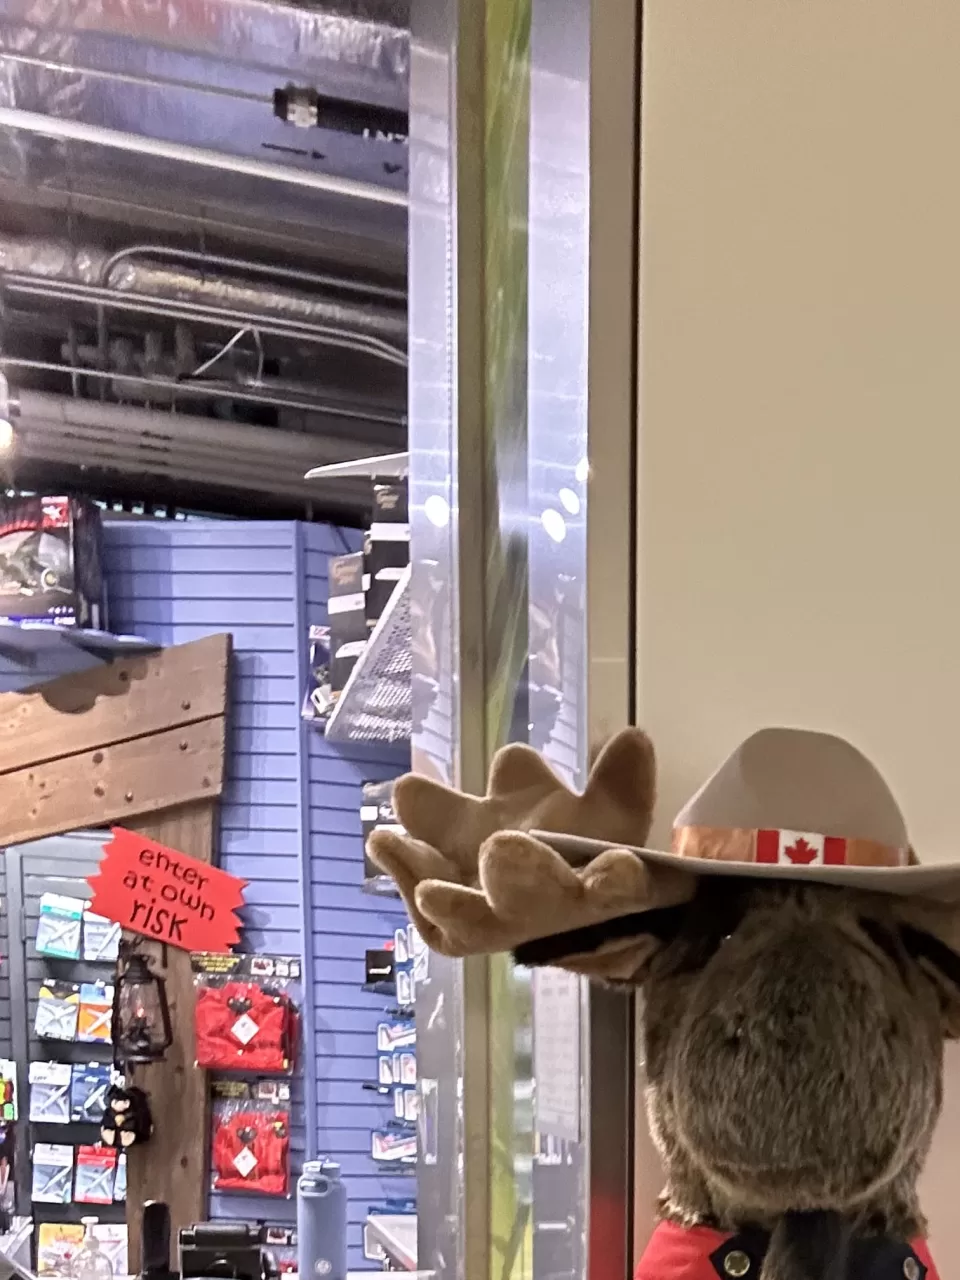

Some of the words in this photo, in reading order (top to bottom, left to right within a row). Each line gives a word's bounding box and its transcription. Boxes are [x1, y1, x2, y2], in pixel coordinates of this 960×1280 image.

[139, 848, 209, 890] enter
[123, 870, 154, 892] at
[161, 884, 215, 921] own
